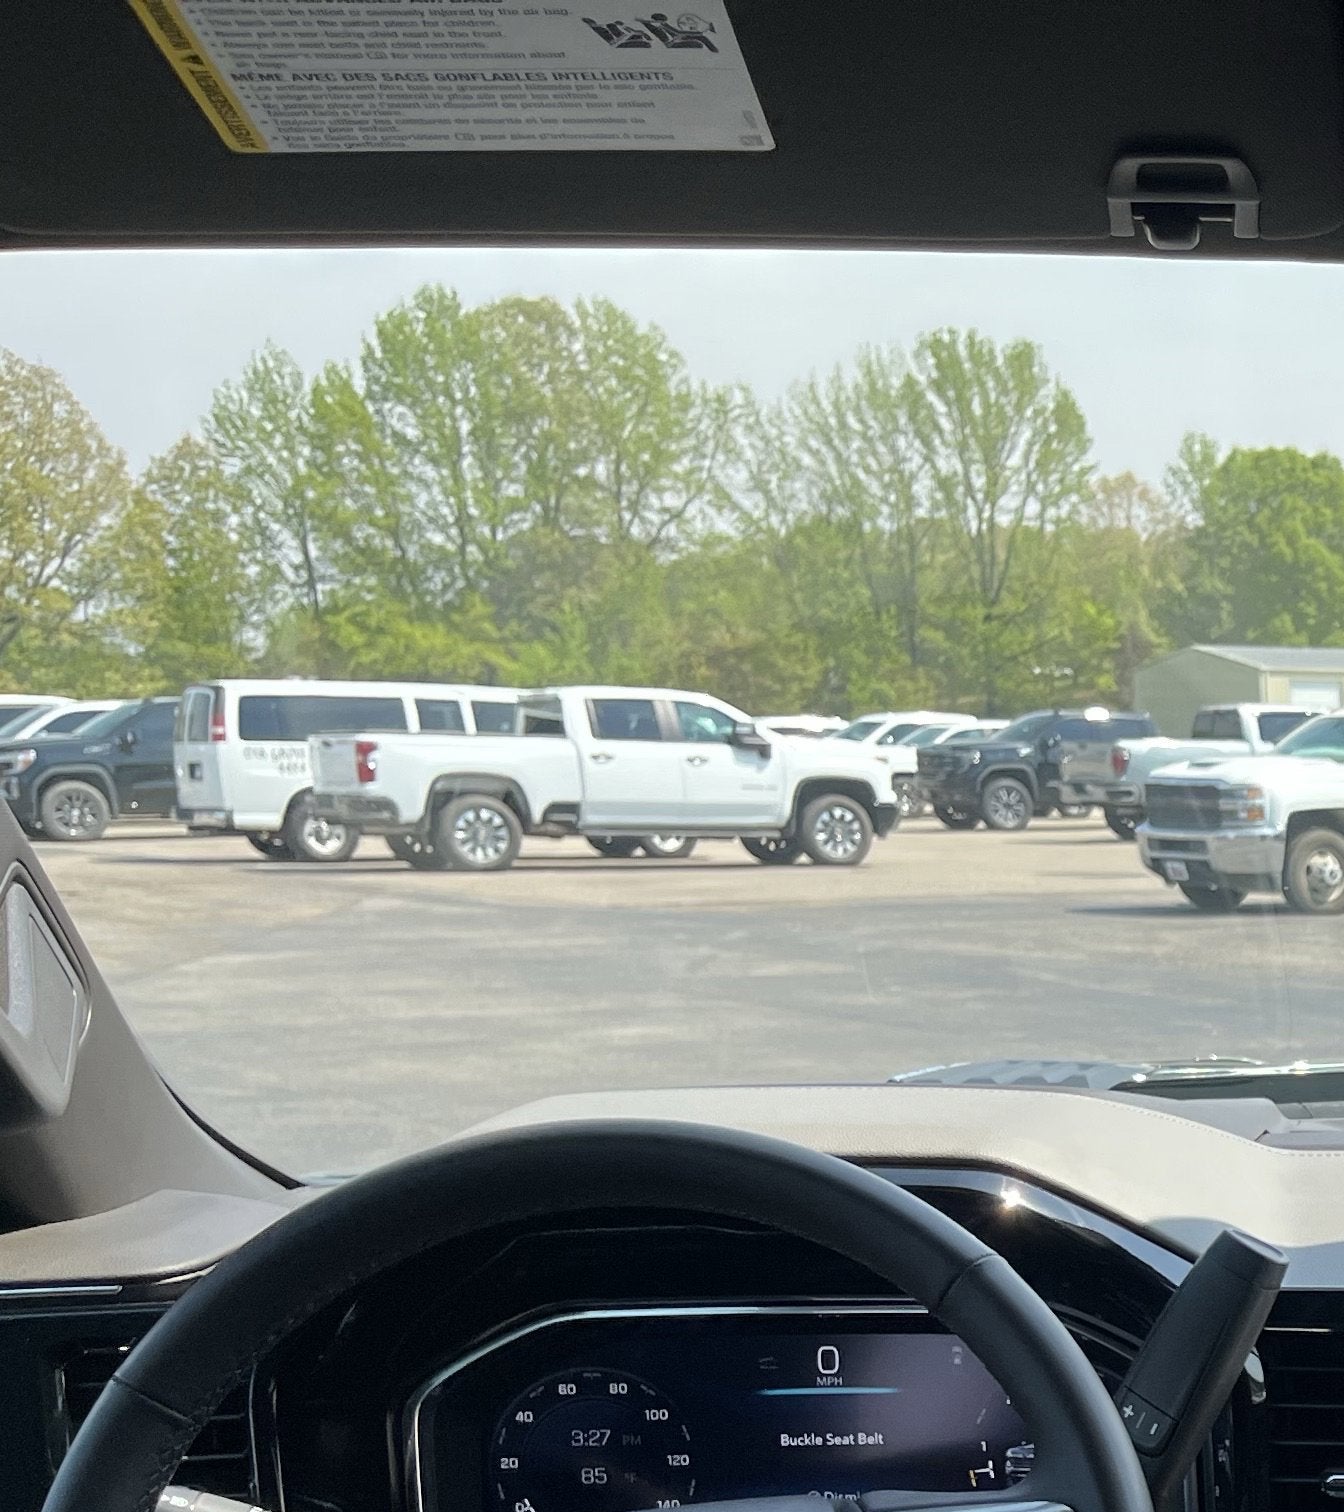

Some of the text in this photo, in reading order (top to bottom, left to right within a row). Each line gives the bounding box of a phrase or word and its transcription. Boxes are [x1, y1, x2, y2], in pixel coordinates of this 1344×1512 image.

[291, 72, 337, 81] AVEC
[342, 72, 377, 81] DES
[381, 72, 428, 81] SACS
[434, 72, 549, 81] GONFLABLES
[552, 72, 675, 81] INTELLIGENTS
[816, 1345, 840, 1375] 0
[816, 1376, 843, 1386] MPH
[557, 1383, 577, 1396] 60
[608, 1382, 628, 1395] 80
[514, 1410, 534, 1424] 40
[645, 1408, 669, 1421] 100
[570, 1429, 611, 1447] 3:27
[780, 1432, 884, 1447] Buckle Seat Belt
[500, 1457, 519, 1469] 20
[666, 1453, 689, 1466] 120
[581, 1467, 608, 1484] 85
